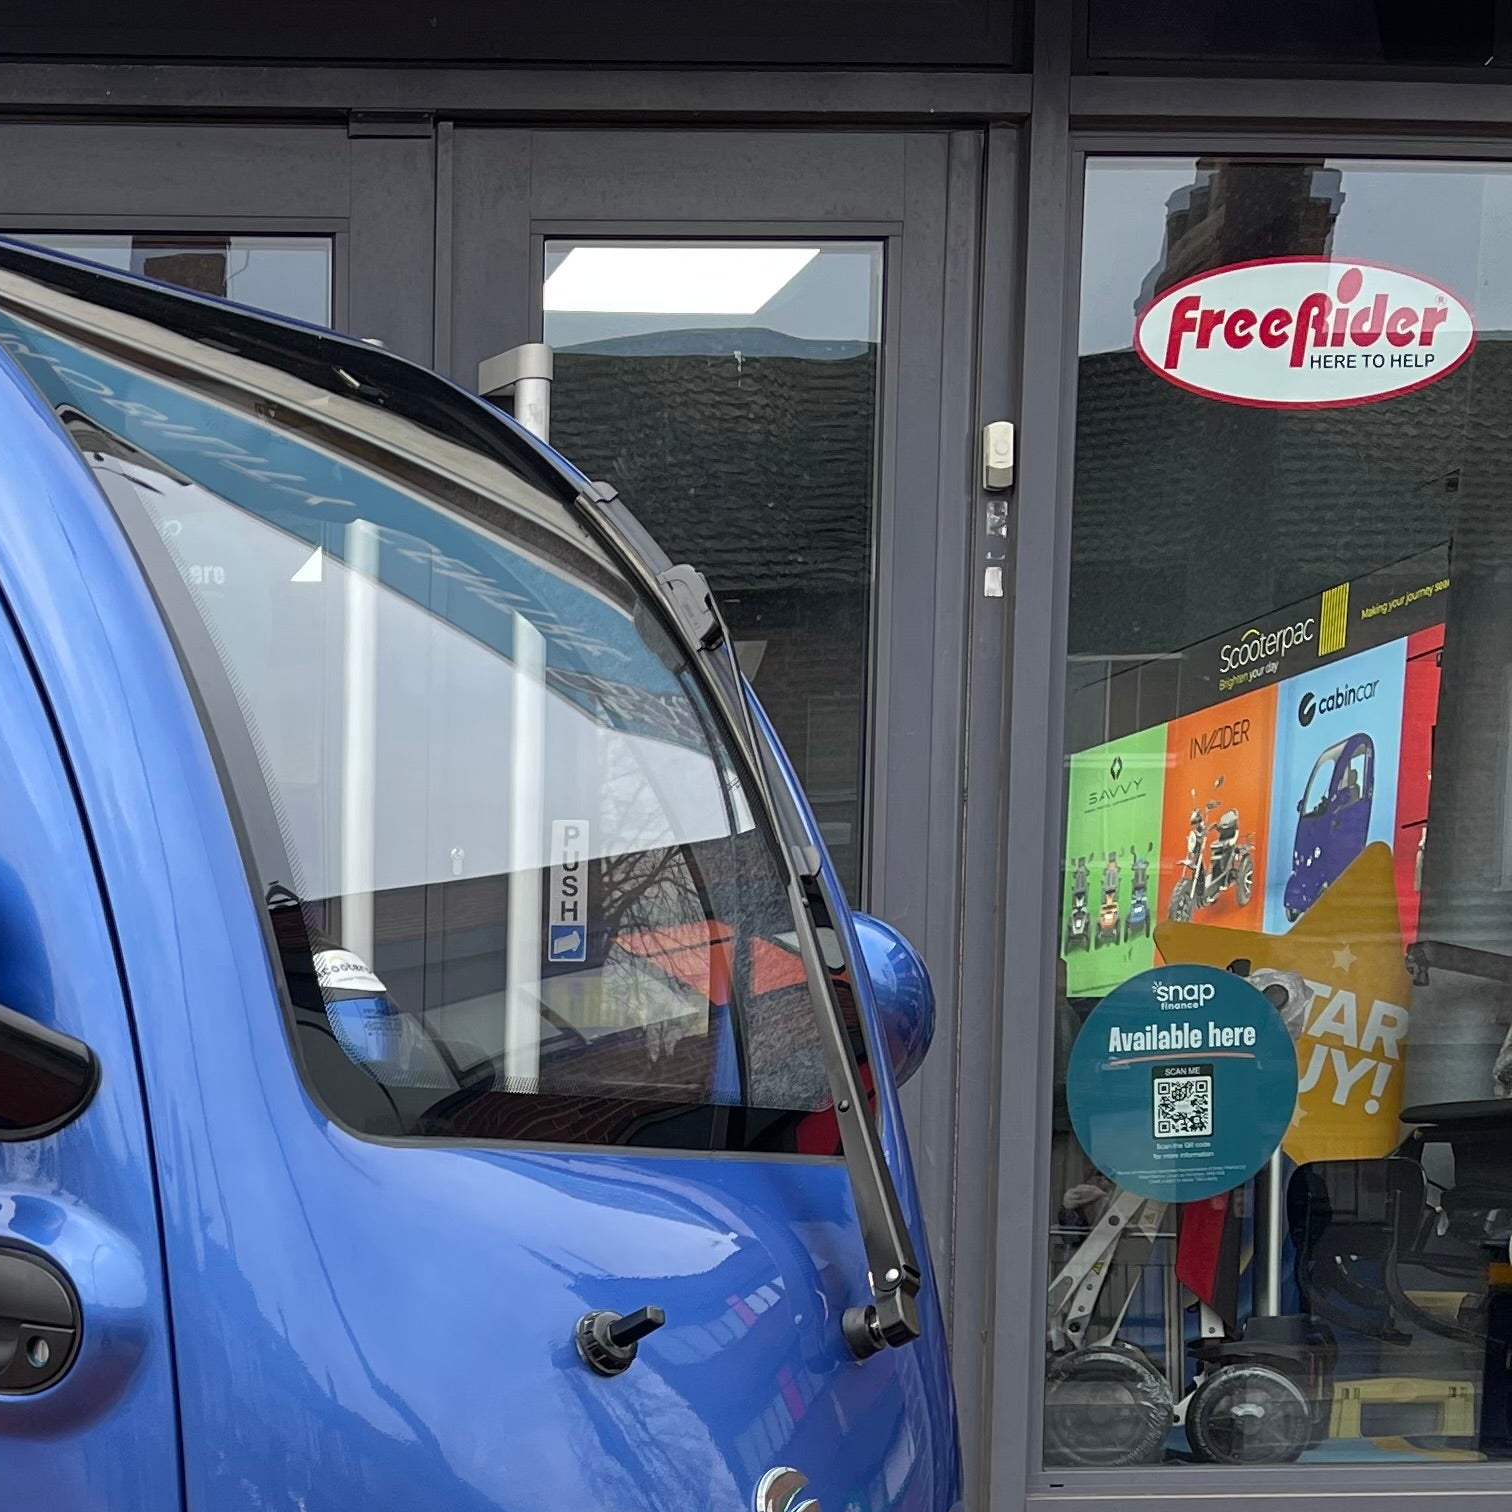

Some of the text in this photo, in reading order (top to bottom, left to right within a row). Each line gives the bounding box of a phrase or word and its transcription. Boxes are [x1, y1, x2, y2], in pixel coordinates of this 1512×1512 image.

[1310, 353, 1436, 369] HERE TO HELP
[1219, 618, 1315, 673] Scooterpac
[1318, 679, 1380, 714] cabincar
[1189, 718, 1251, 760] INVADER
[1088, 776, 1144, 806] SAVVY
[561, 826, 580, 921] PUSH
[1154, 983, 1216, 1006] snap
[1161, 1001, 1199, 1011] finance
[1108, 1021, 1256, 1053] Available here
[1164, 1066, 1201, 1077] SCAN ME
